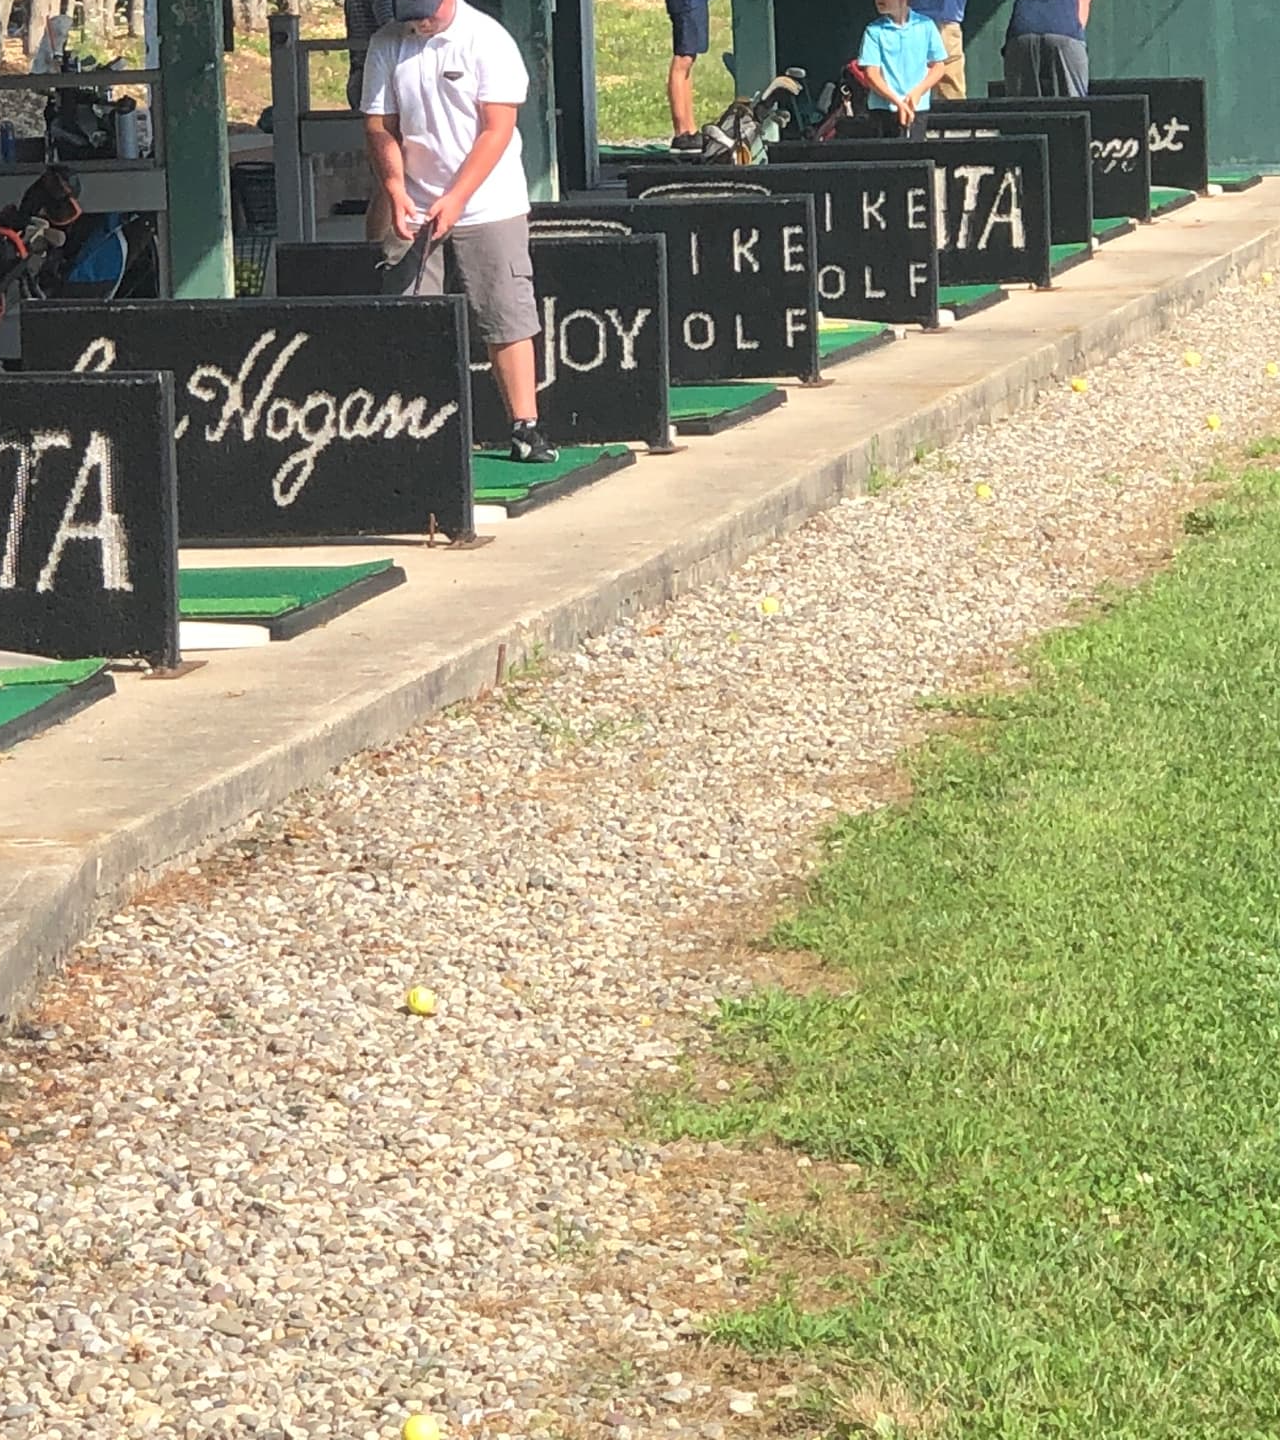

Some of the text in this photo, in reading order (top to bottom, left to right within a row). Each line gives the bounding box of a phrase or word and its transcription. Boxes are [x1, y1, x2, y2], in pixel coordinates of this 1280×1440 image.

[823, 187, 928, 233] IKE
[689, 225, 806, 276] IKE
[818, 262, 928, 300] OLF
[534, 295, 653, 393] JOY
[682, 308, 808, 350] OLF
